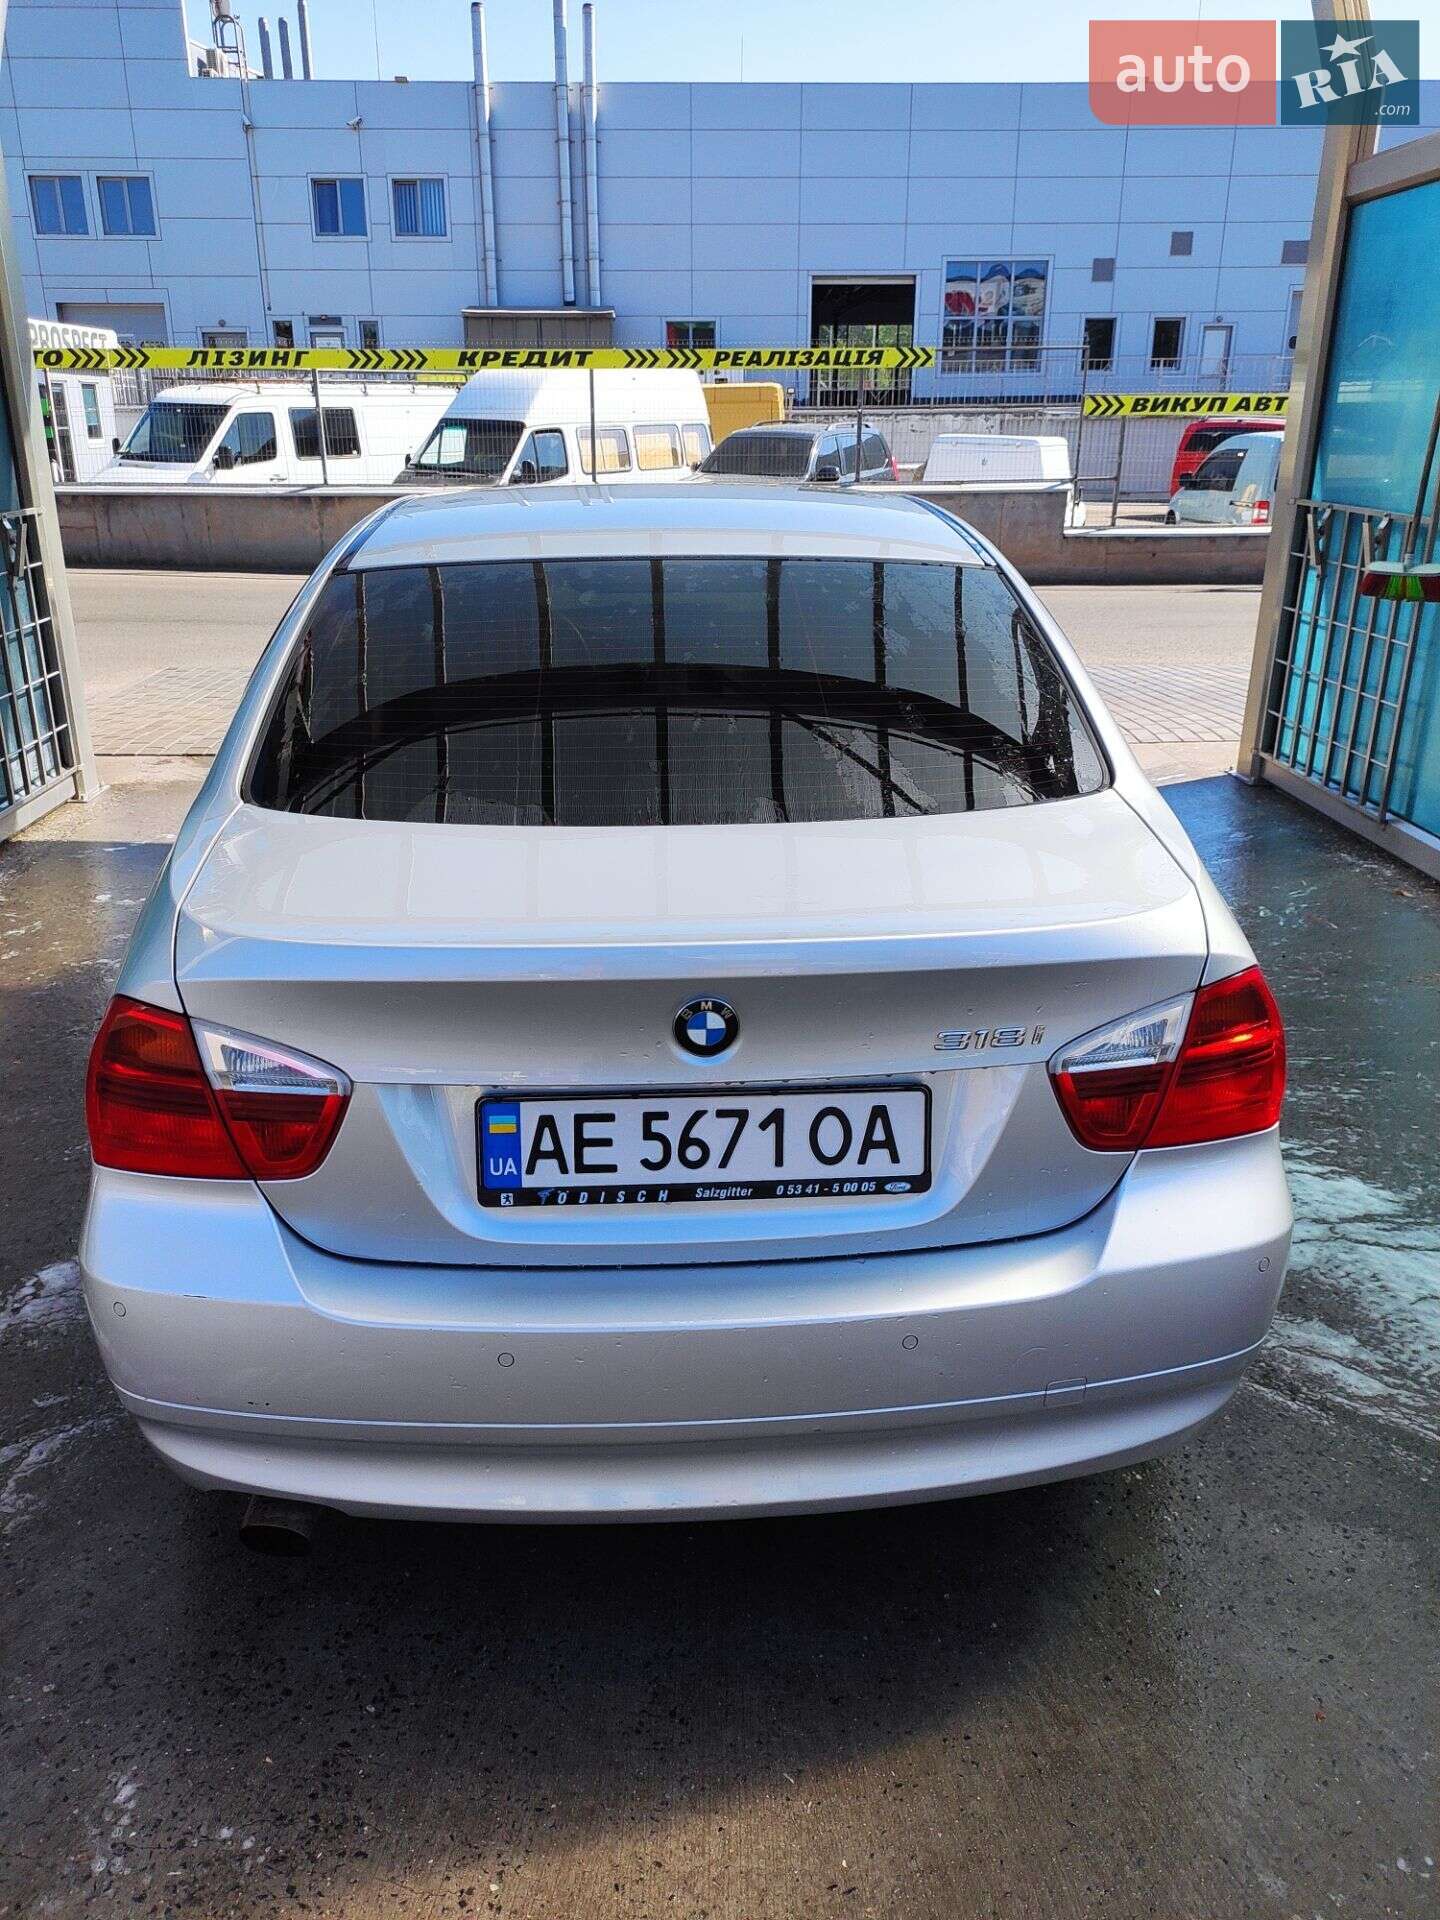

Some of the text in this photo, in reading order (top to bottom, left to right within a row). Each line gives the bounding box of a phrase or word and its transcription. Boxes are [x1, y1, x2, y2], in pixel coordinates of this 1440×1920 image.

[186, 350, 310, 367] ЛІЗИНГ
[457, 350, 594, 368] КРЕДИТ
[713, 349, 886, 367] РЕАЛІЗАЦІЯ
[1130, 396, 1228, 413] ВИКУП
[681, 1001, 733, 1020] BMW
[525, 1104, 901, 1175] AE 5671 OA
[489, 1157, 518, 1177] UA
[695, 1186, 753, 1200] Salzgitter
